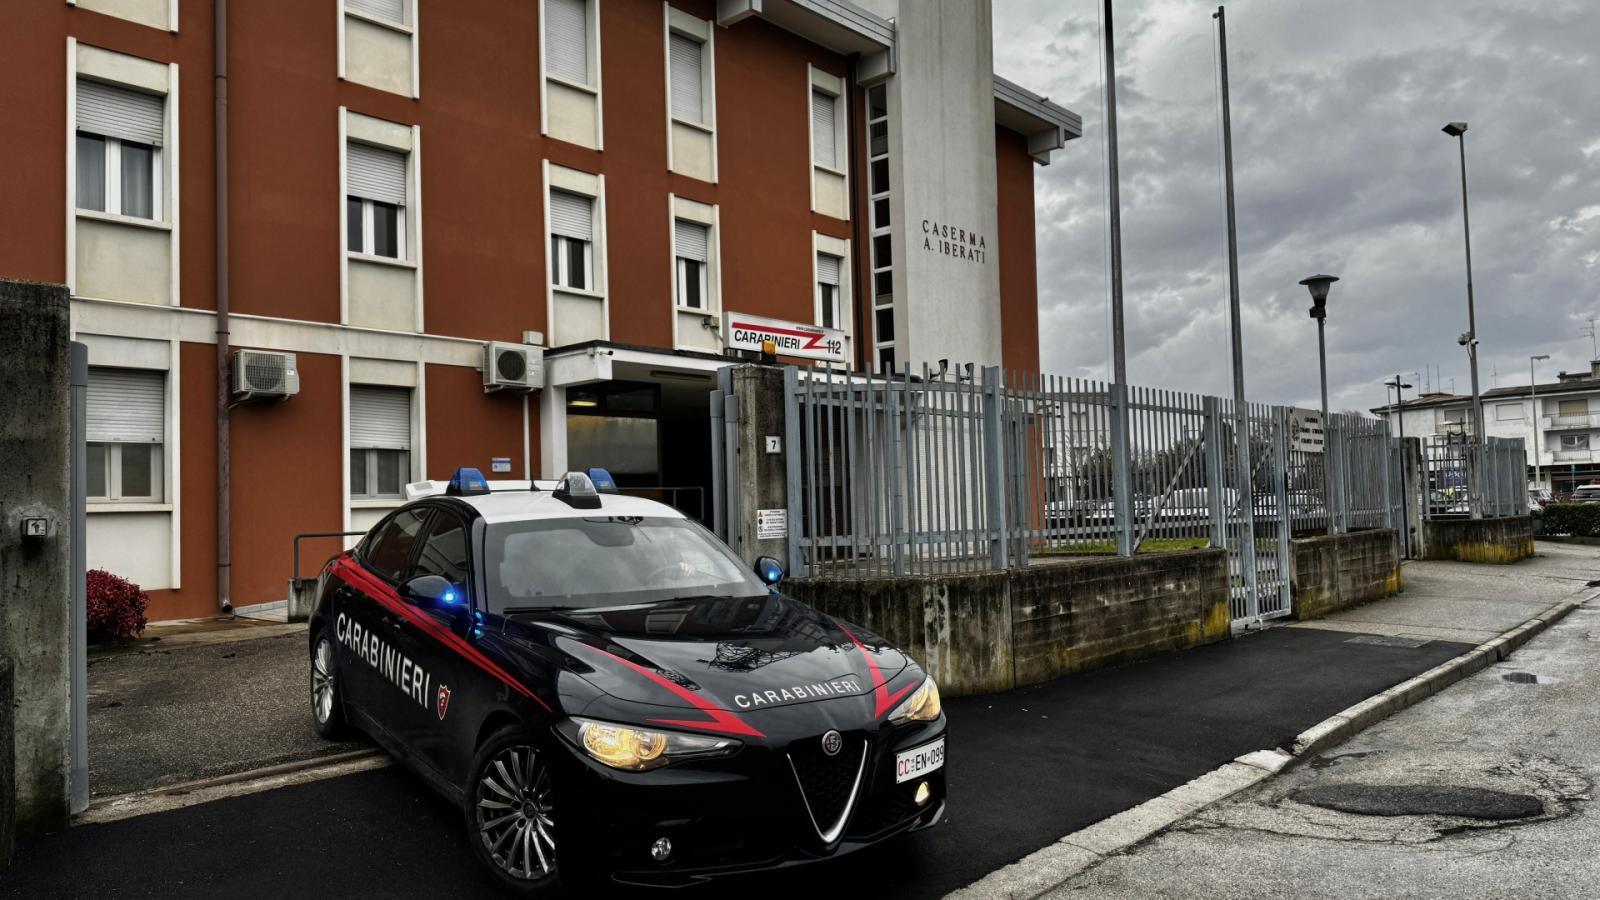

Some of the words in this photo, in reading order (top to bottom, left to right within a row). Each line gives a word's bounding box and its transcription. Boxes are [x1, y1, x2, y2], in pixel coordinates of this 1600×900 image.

[922, 219, 986, 249] CASERMA
[923, 236, 934, 251] A.
[939, 240, 985, 264] IBERATI
[826, 339, 842, 354] 112
[771, 440, 777, 450] 7
[337, 612, 431, 710] CARABINIERI
[734, 680, 861, 708] CARABINIERI
[898, 758, 910, 777] CC
[915, 752, 927, 771] EN
